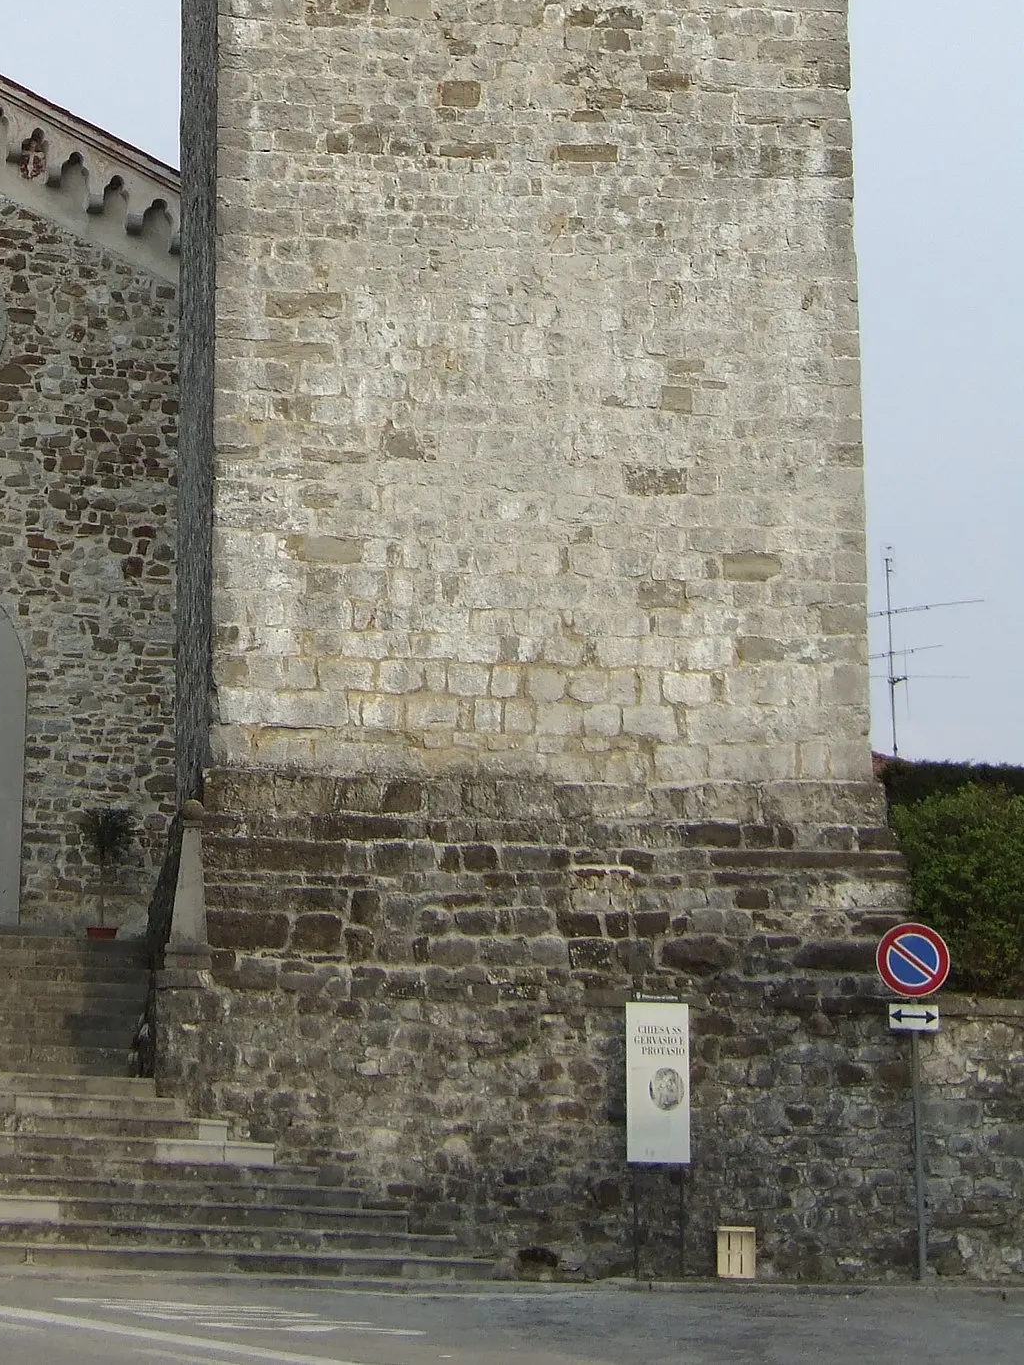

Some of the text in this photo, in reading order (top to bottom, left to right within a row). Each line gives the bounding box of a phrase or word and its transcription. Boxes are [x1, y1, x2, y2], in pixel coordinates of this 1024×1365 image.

[637, 1025, 670, 1035] CHIESA
[634, 1036, 677, 1045] GERVASIO
[641, 1047, 685, 1055] PROTASIO
